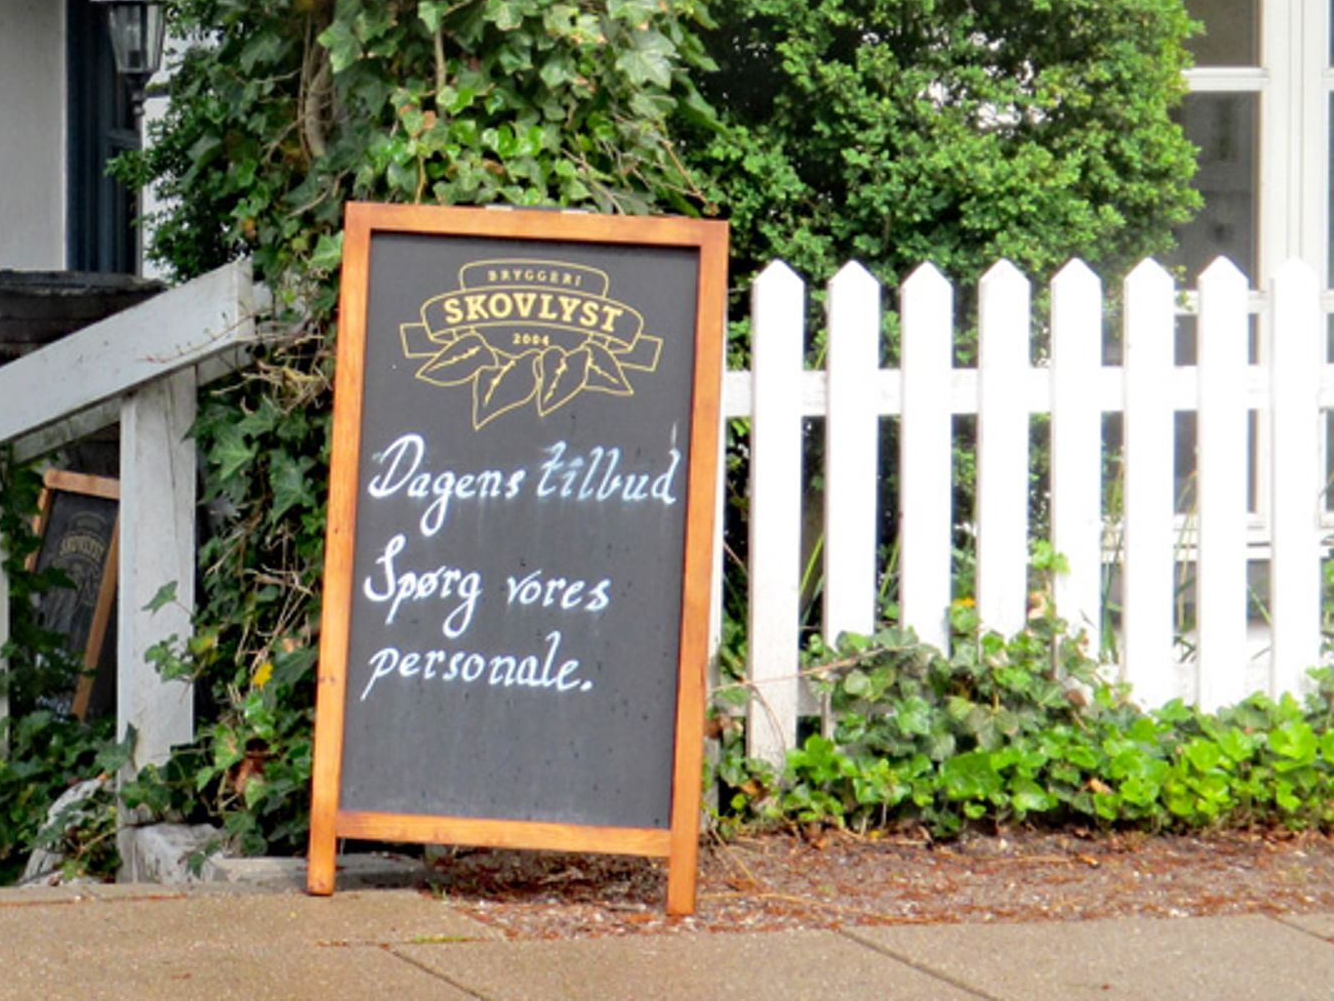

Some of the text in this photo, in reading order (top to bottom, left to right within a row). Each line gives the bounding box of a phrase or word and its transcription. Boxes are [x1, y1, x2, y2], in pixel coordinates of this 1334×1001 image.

[443, 292, 623, 332] SKOVLYST
[487, 269, 582, 287] BRYGGERI
[368, 434, 682, 535] Dagens tilbud
[364, 535, 611, 639] Spørg vores
[360, 631, 593, 702] personale.
